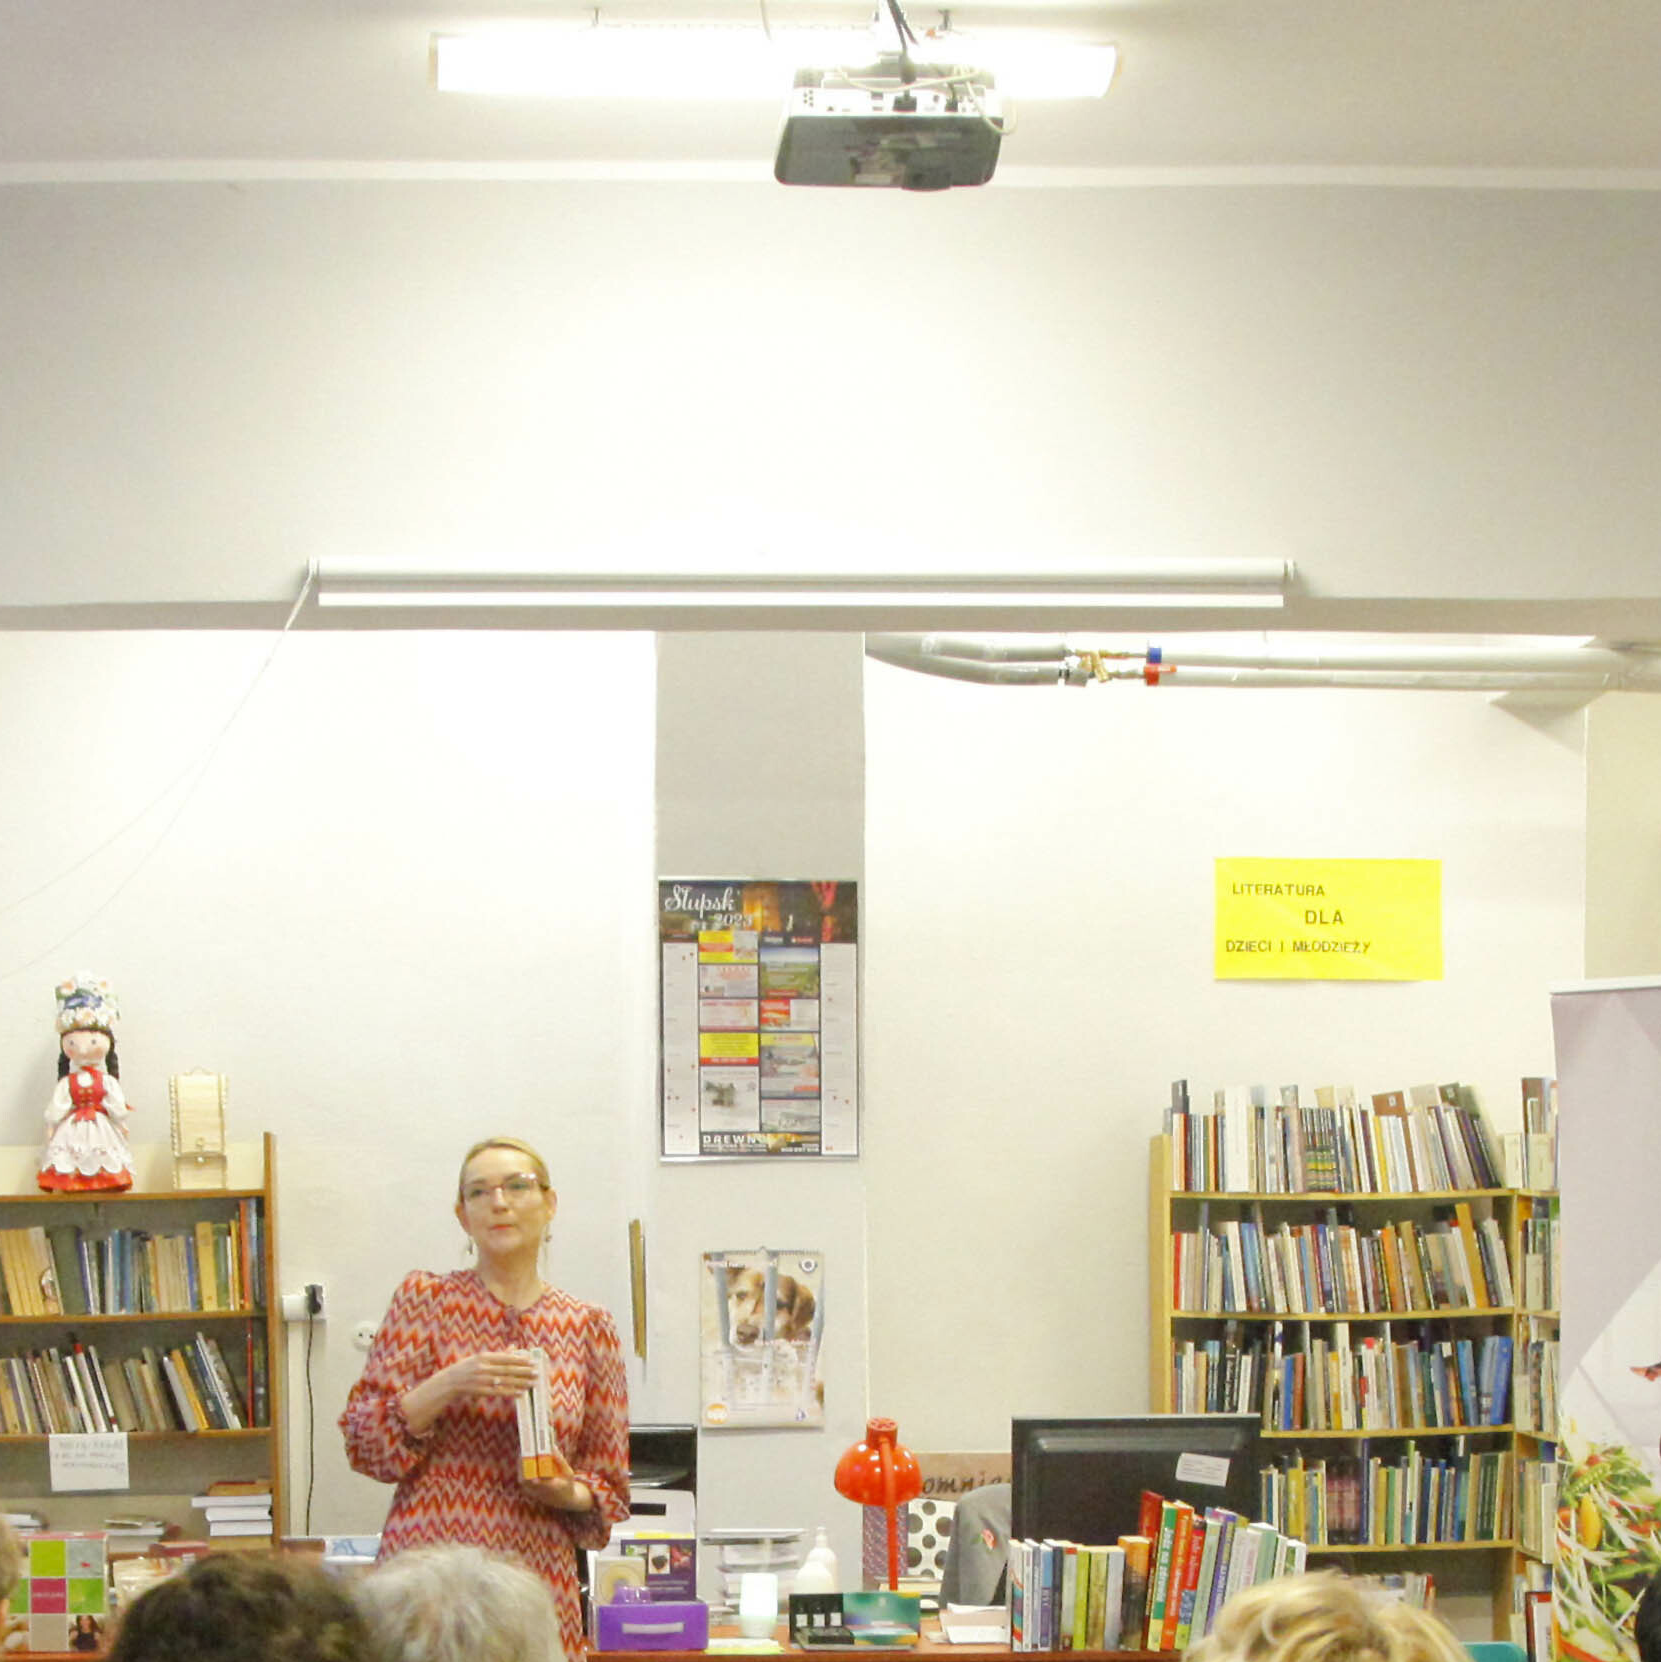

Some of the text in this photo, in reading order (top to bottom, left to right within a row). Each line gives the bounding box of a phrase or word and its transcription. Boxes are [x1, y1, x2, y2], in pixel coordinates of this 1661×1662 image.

[1232, 882, 1326, 897] LITERATURA
[1304, 909, 1344, 925] DLA
[1225, 939, 1272, 953] DZIECI
[1293, 940, 1371, 954] MŁODZIEŻY
[1160, 1551, 1171, 1564] na
